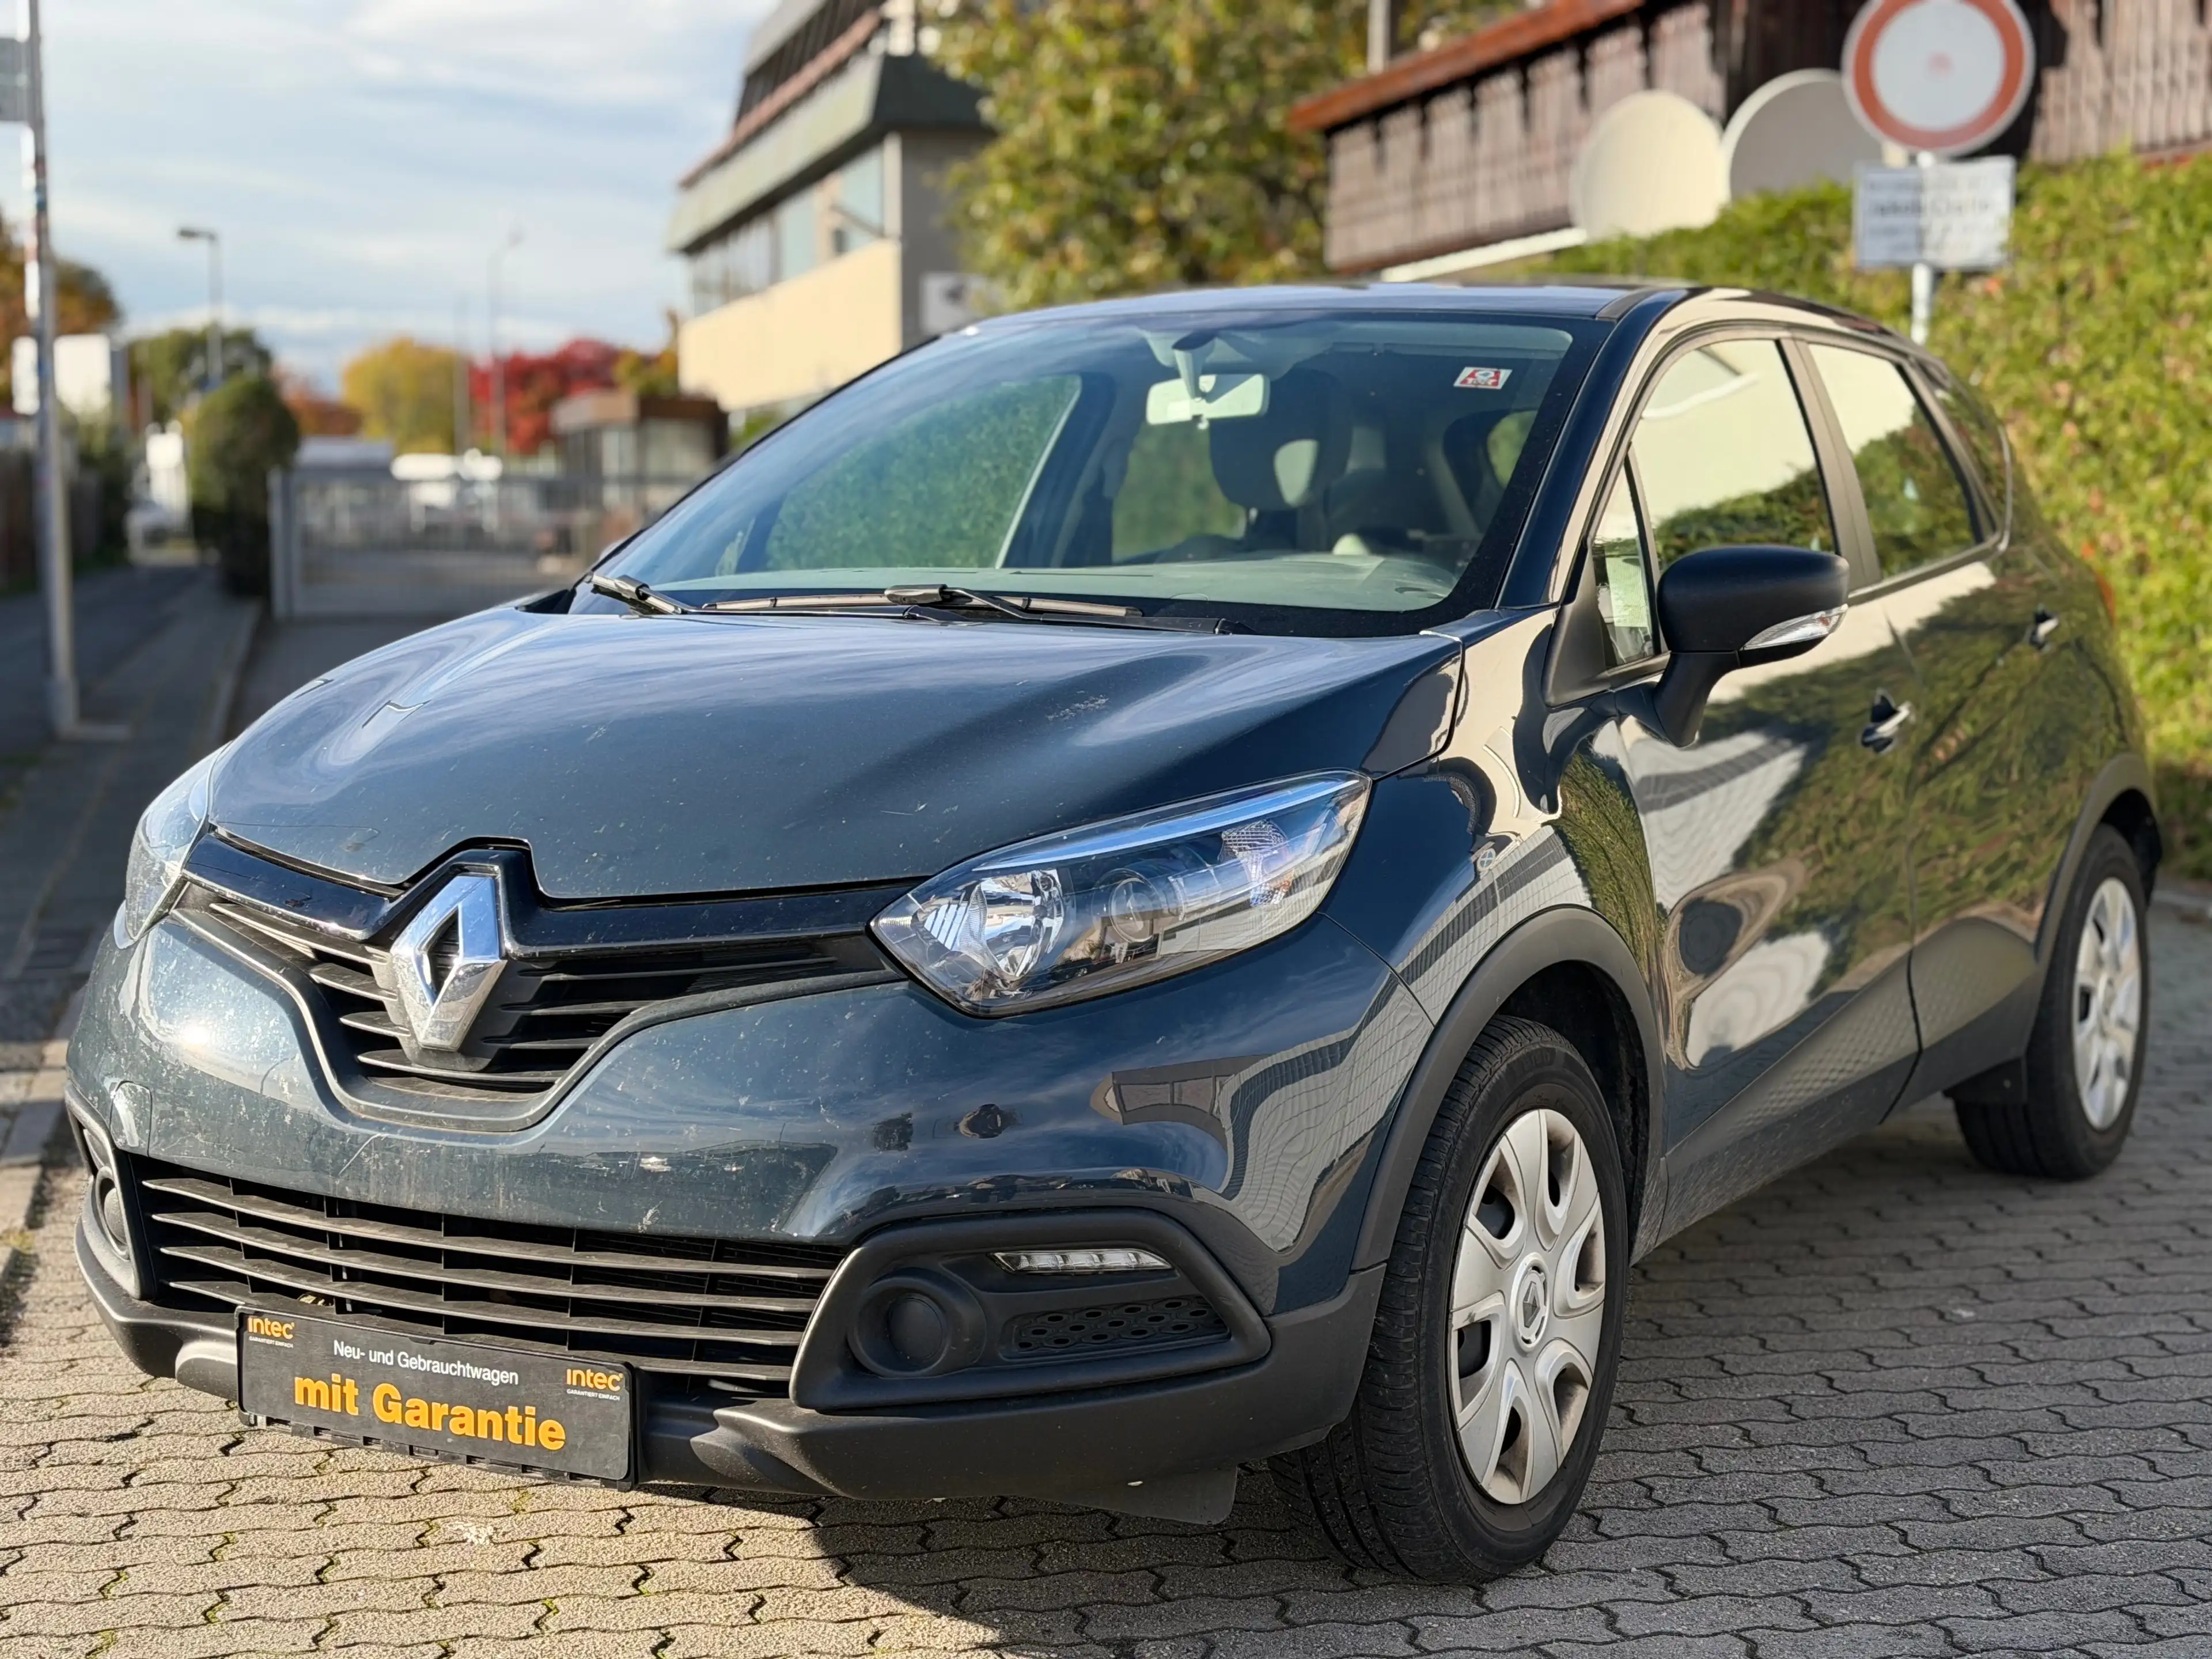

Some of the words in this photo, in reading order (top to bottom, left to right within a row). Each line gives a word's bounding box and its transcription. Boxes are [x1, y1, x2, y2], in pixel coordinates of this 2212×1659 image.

[334, 1339, 365, 1359] Neu-
[369, 1350, 394, 1365] und
[397, 1351, 518, 1386] Gebrauchtwagen
[294, 1374, 359, 1416] mit
[372, 1383, 566, 1450] Garantie
